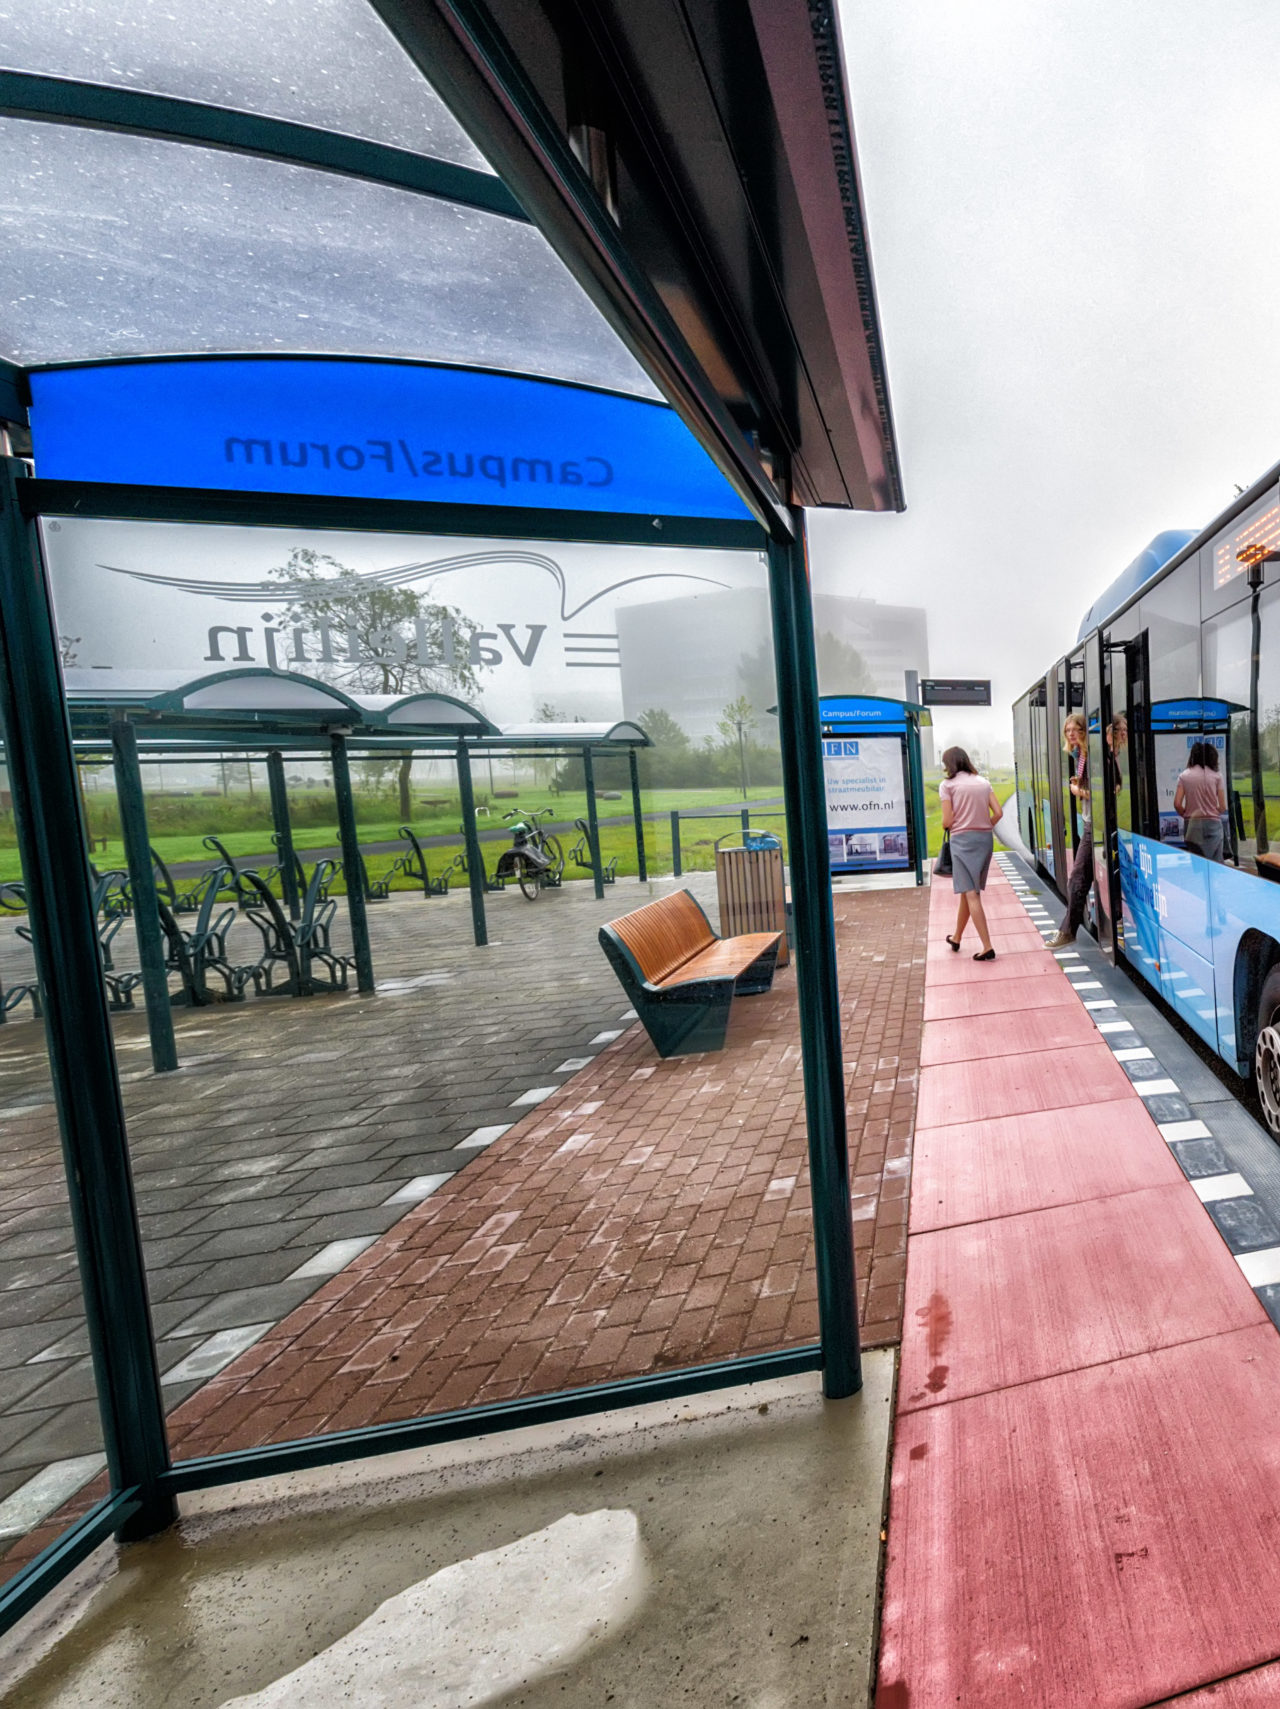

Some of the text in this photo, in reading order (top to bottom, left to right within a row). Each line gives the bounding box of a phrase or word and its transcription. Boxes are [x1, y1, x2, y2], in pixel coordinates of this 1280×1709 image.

[822, 710, 882, 718] Campus/Forum
[842, 777, 877, 785] specialist
[829, 800, 894, 812] www.ofn.nl
